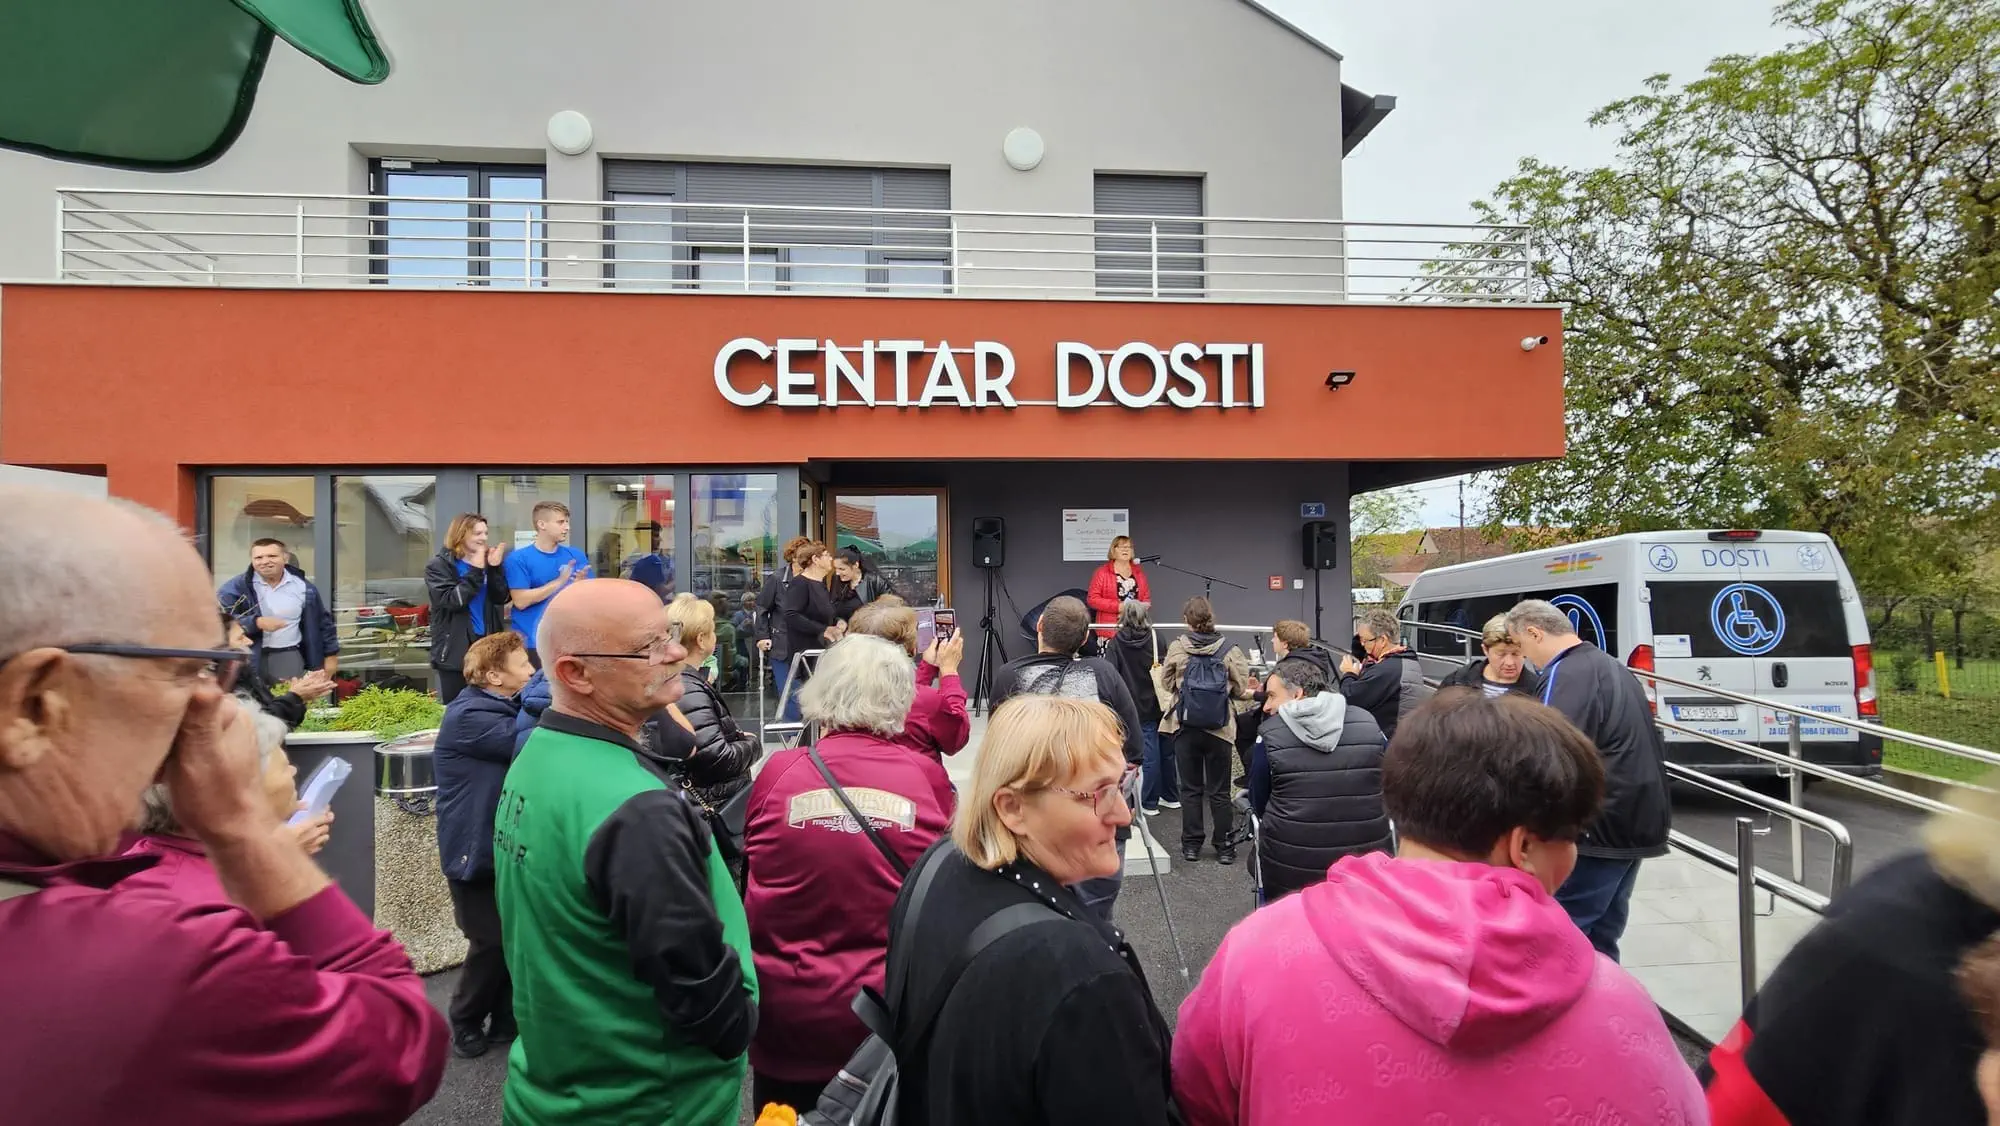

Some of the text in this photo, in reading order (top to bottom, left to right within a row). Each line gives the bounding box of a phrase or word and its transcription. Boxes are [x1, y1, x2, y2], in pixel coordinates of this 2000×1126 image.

[714, 337, 1265, 408] CENTAR DOSTI
[1702, 549, 1770, 567] DOSTI
[1365, 1042, 1458, 1088] Barbie
